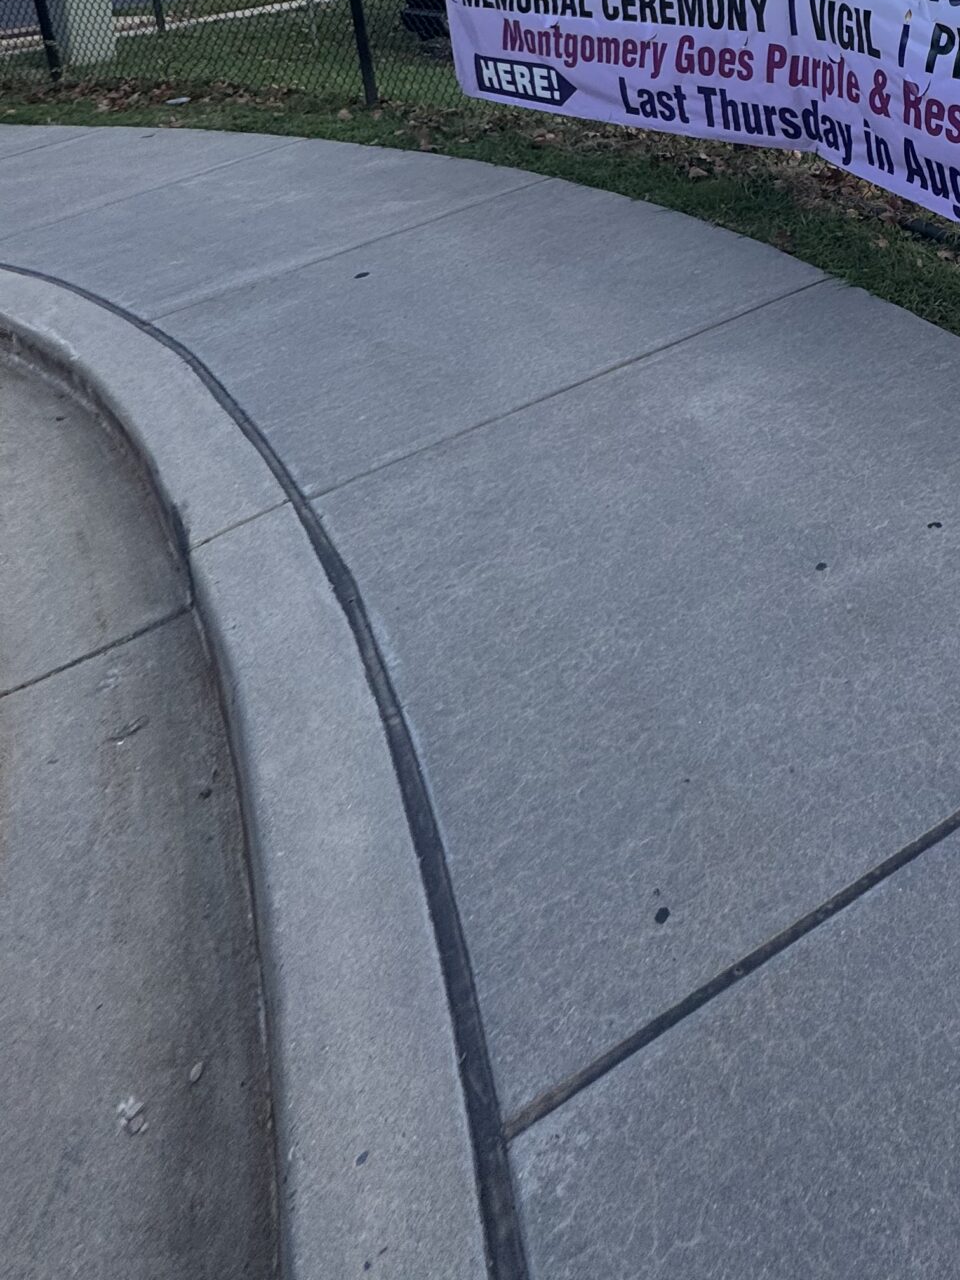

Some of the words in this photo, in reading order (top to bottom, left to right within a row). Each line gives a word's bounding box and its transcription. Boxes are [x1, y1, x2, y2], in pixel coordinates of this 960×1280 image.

[480, 60, 561, 100] HERE!
[502, 18, 668, 79] Montgomery
[675, 35, 754, 81] Goes
[766, 43, 861, 103] Purple
[869, 69, 892, 118] &
[618, 77, 690, 124] Last
[697, 85, 852, 166] Thursday
[863, 119, 895, 175] in
